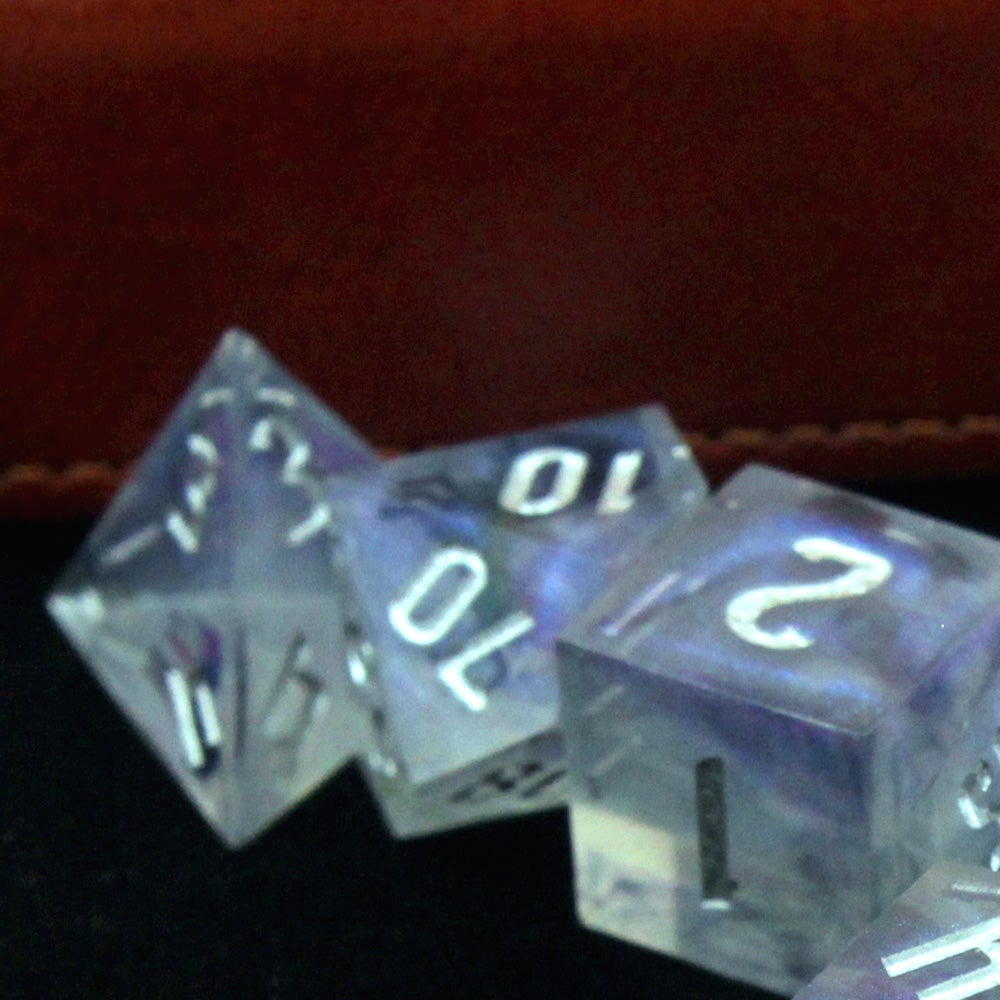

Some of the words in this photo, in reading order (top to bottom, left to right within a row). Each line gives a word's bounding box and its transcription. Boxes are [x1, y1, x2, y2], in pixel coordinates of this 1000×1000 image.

[497, 445, 644, 517] 10
[388, 545, 536, 713] 70
[724, 536, 893, 651] 2
[694, 755, 739, 911] 1
